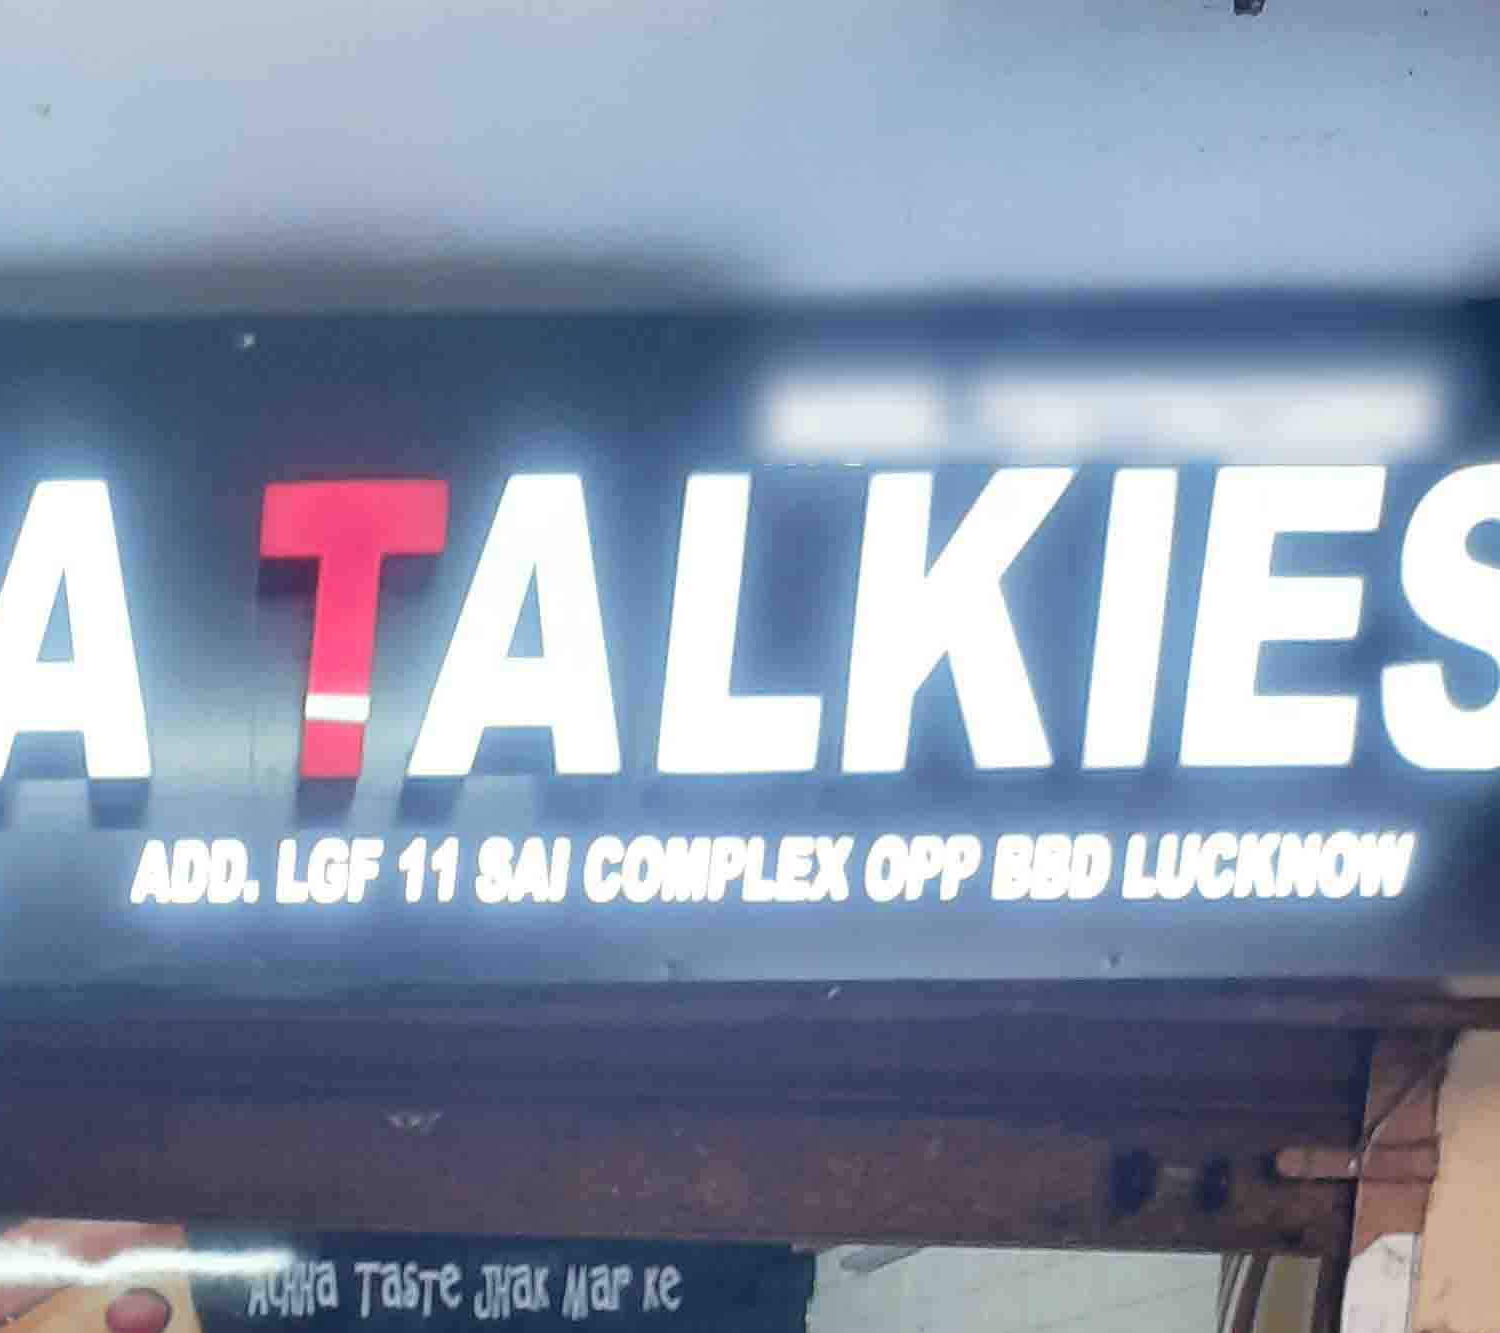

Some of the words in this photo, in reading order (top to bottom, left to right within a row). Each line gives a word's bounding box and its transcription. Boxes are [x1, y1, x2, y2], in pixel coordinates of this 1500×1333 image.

[259, 463, 1500, 779] TALKIES
[130, 838, 259, 903] ADD.
[275, 838, 384, 903] LGF
[398, 837, 459, 901] 11
[475, 836, 572, 903] SAI
[582, 834, 854, 902] COMPLEX
[864, 834, 981, 901] OPP
[991, 833, 1112, 900] BBD
[1121, 830, 1417, 899] LUCKNOW
